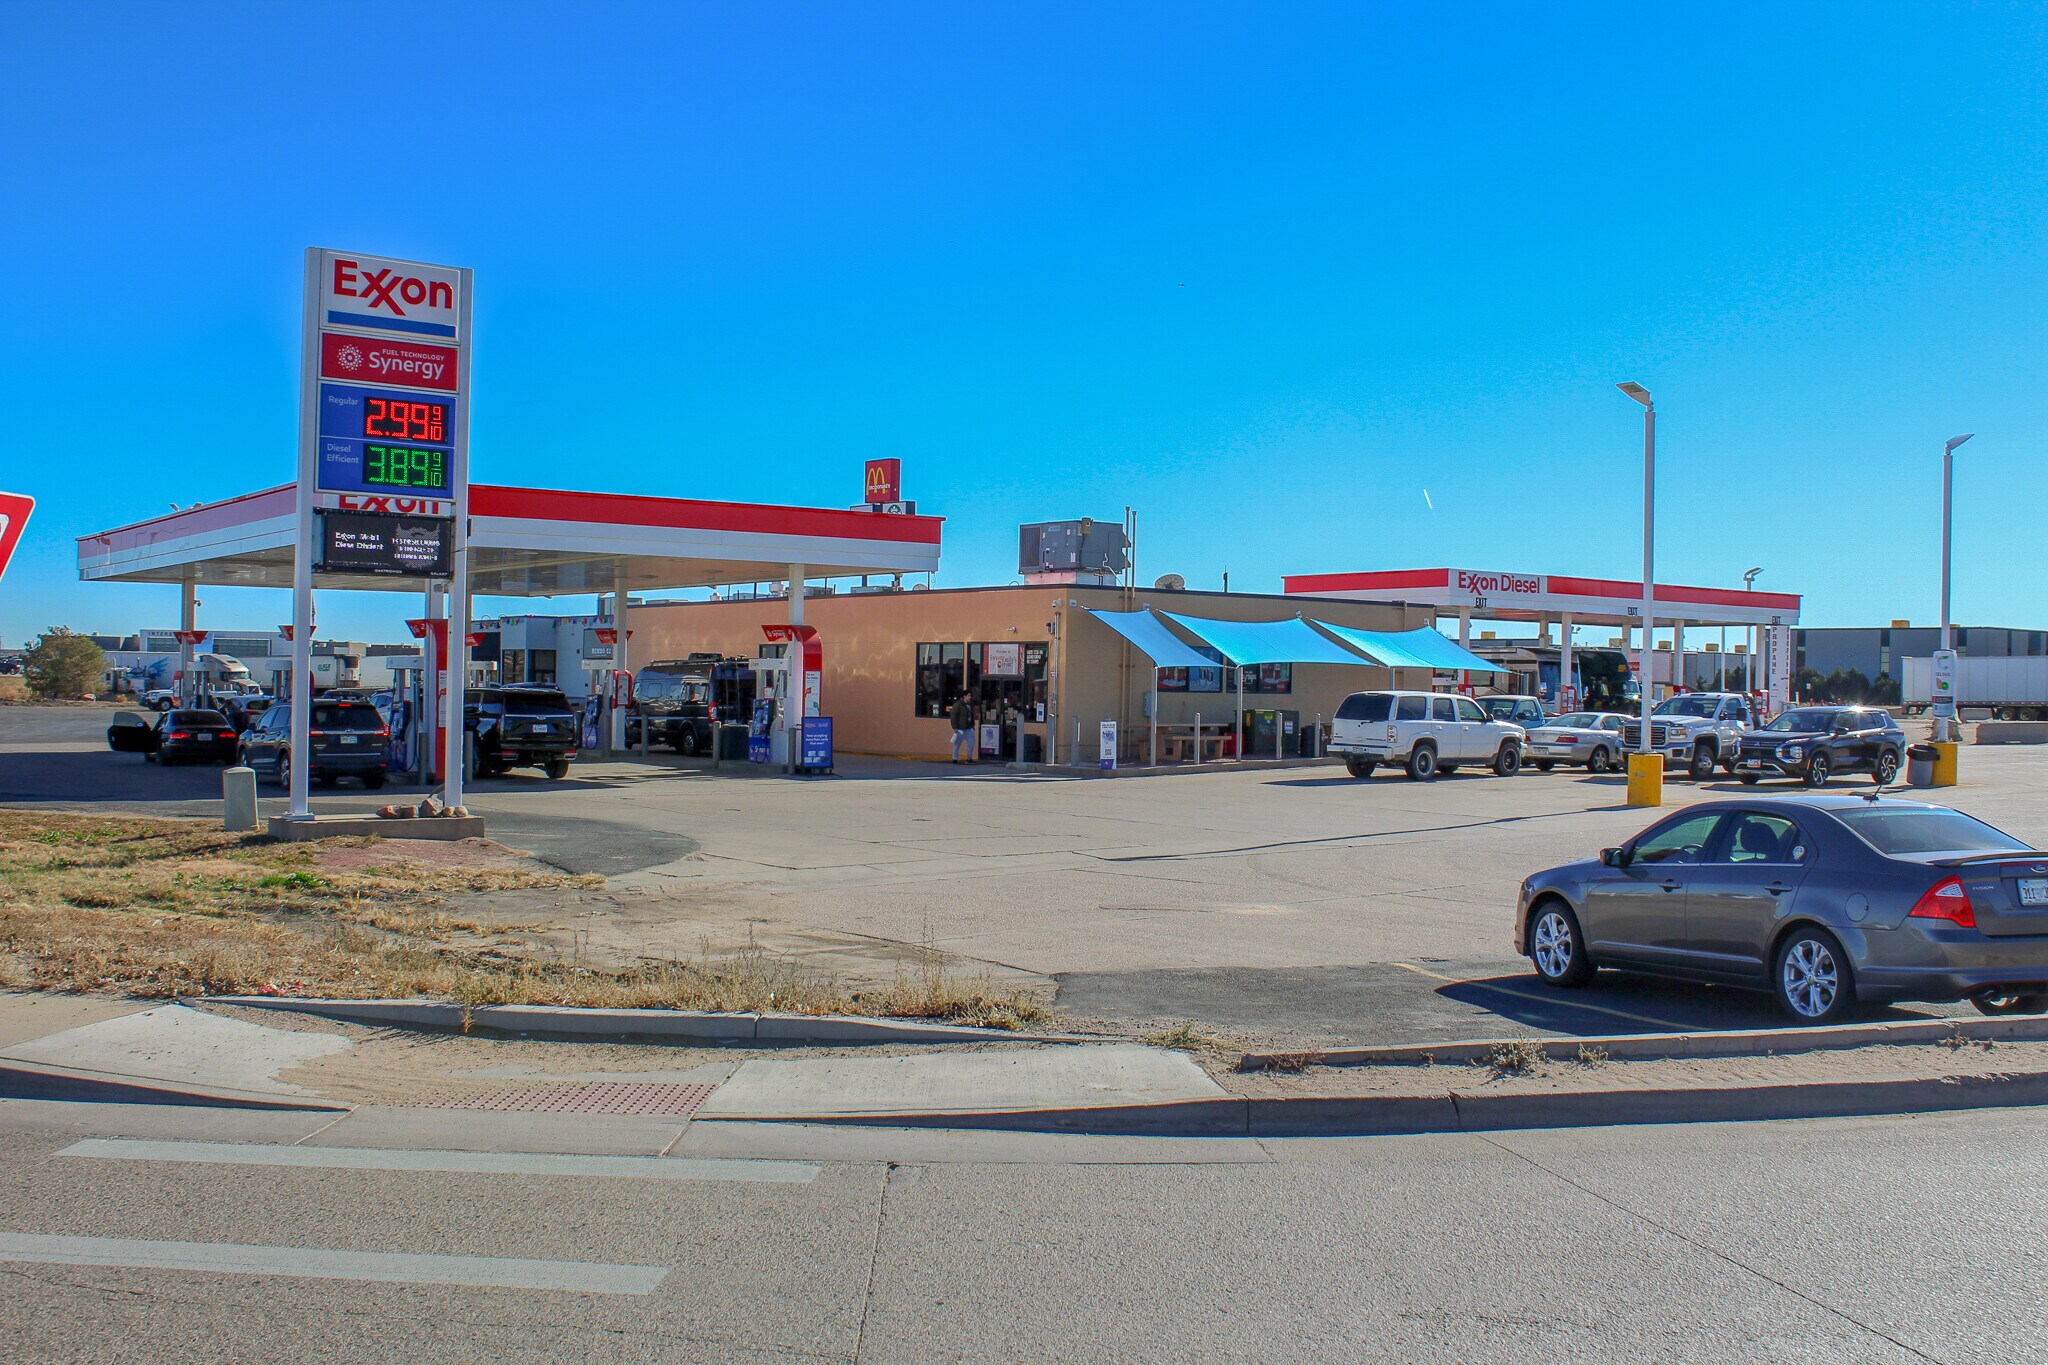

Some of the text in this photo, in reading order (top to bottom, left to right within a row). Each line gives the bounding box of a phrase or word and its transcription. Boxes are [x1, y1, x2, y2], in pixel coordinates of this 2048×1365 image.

[334, 258, 453, 316] Exxon
[383, 348, 445, 361] FUEL TECHNOLOGY
[369, 351, 445, 380] Synergy
[328, 395, 359, 406] Regular
[366, 399, 430, 439] 2.99
[327, 443, 351, 453] Diesel
[326, 453, 359, 464] Efficient
[368, 446, 429, 486] 3.89
[1458, 571, 1540, 596] Exxon Diesel
[1475, 597, 1488, 608] EXIT
[1627, 607, 1638, 616] EXIT
